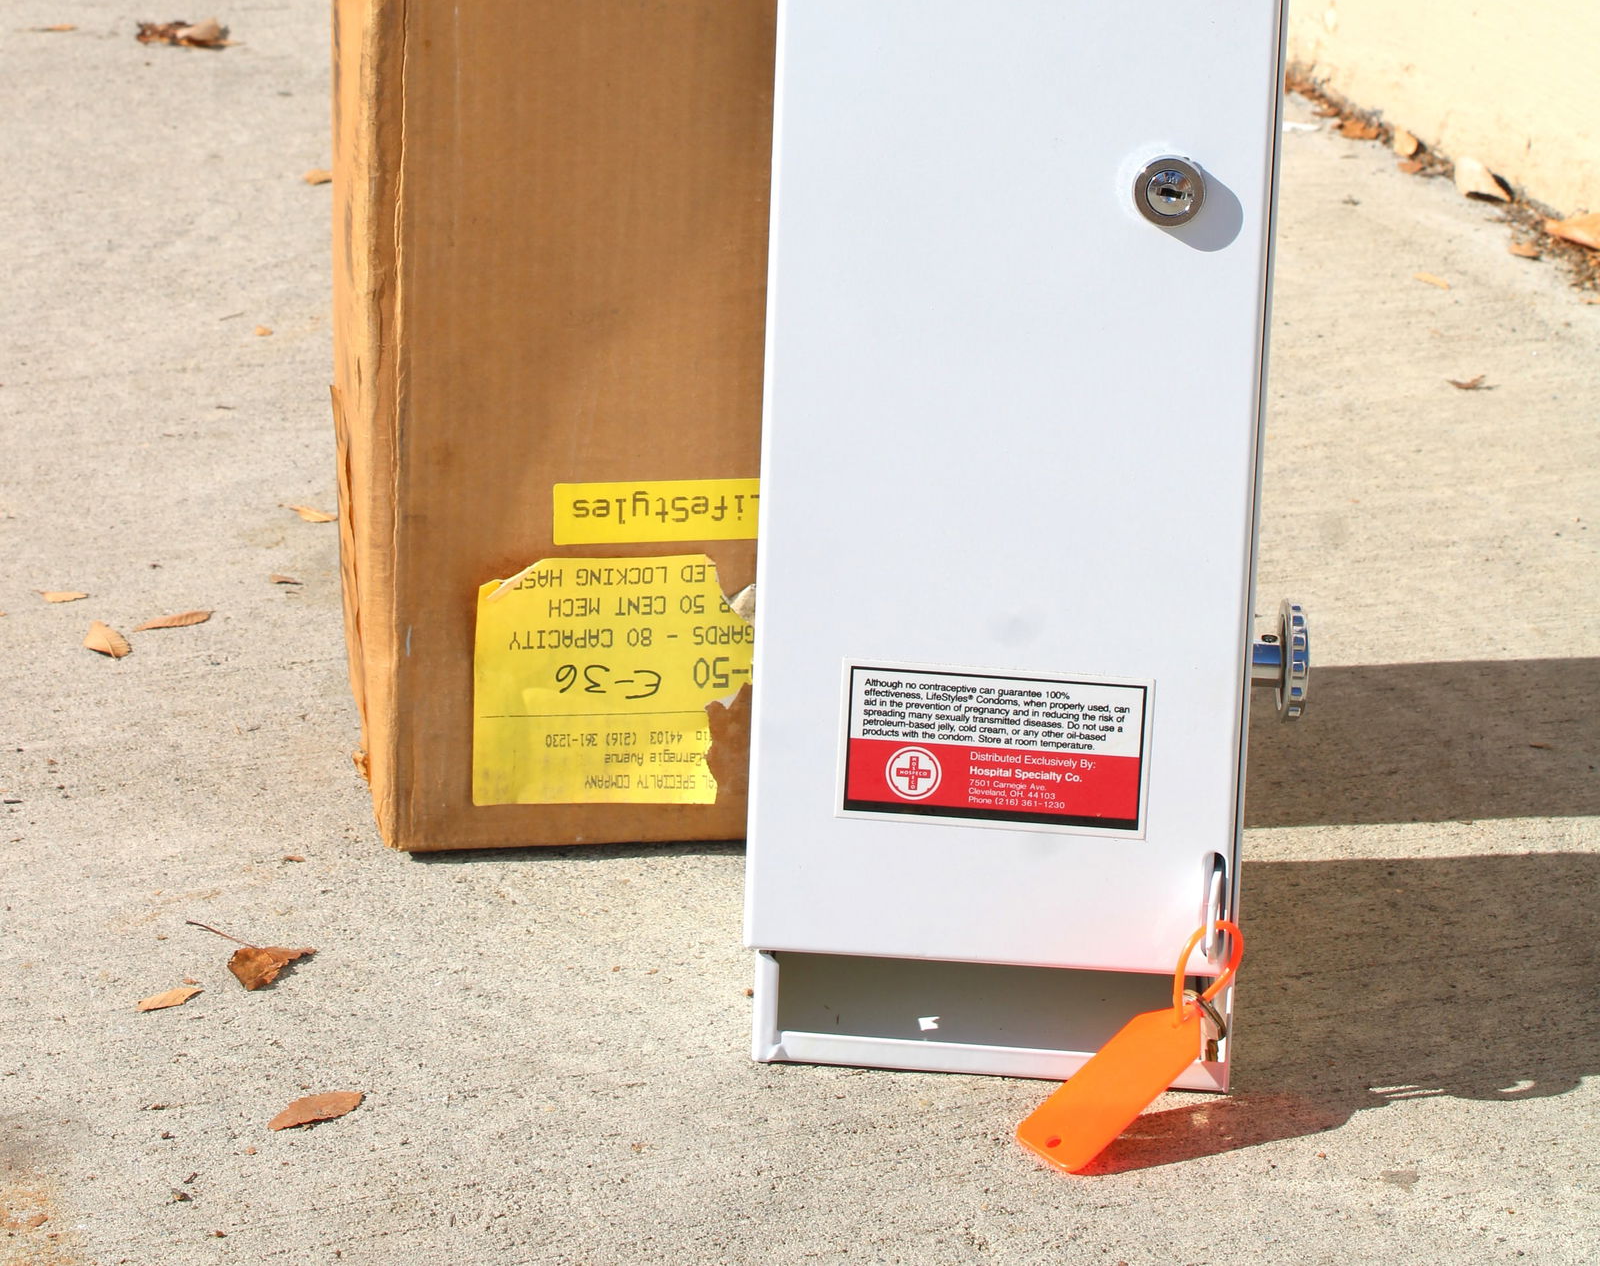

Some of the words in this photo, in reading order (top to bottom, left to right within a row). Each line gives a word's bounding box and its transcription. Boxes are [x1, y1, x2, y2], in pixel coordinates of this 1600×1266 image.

[573, 490, 761, 524] ifeStyles
[576, 566, 668, 586] LOCKING
[548, 598, 601, 618] MECH
[615, 596, 666, 617] CENT
[680, 595, 705, 614] 50
[509, 629, 614, 651] CAPACITY
[626, 628, 653, 647] 80
[865, 678, 902, 690] Although
[919, 681, 976, 695] contraceptive
[998, 686, 1041, 699] guarantee
[1046, 690, 1069, 699] 100%
[864, 687, 922, 700] effectiveness,
[976, 695, 1019, 706] Condoms,
[1023, 698, 1046, 707] when
[1049, 700, 1084, 712] properly
[1087, 702, 1110, 712] used,
[864, 697, 876, 706] aid
[879, 698, 886, 706] in
[889, 699, 902, 707] the
[905, 700, 950, 713] prevention
[953, 703, 961, 711] of
[964, 706, 1009, 717] pregnancy
[1012, 707, 1028, 716] and
[1032, 708, 1038, 716] in
[1042, 709, 1079, 721] reducing
[1082, 711, 1095, 720] the
[1098, 712, 1112, 721] risk
[1116, 714, 1124, 722] of
[864, 707, 905, 720] spreading
[908, 712, 932, 721] many
[935, 711, 969, 724] sexually
[972, 714, 1020, 725] transmitted
[1023, 717, 1064, 728] diseases.
[1067, 720, 1079, 729] Do
[1082, 721, 1095, 730] not
[863, 716, 934, 731] petroleum-based
[938, 721, 954, 733] jelly,
[958, 723, 976, 732] cold
[979, 726, 1007, 735] cream,
[1023, 729, 1038, 738] any
[1041, 728, 1063, 737] other
[1066, 730, 1105, 740] oil-based
[545, 732, 598, 747] 361-1230
[606, 732, 637, 747] (216)
[649, 731, 683, 745] 44103
[862, 726, 898, 738] products
[902, 729, 918, 737] with
[922, 730, 934, 739] the
[938, 731, 974, 741] condom.
[978, 734, 1000, 743] Store
[1004, 735, 1011, 744] at
[1040, 738, 1094, 751] temperature.
[604, 753, 645, 766] Avenue
[970, 751, 1021, 764] Distributed
[1024, 755, 1077, 769] Exclusively
[1080, 758, 1095, 770] By:
[584, 775, 630, 789] COMPANY
[636, 774, 696, 789] SPECIALTY
[970, 766, 1011, 779] Hospital
[1014, 768, 1062, 782] Specialty
[1065, 772, 1081, 782] Co.
[968, 787, 1008, 797] Cleveland,
[1028, 790, 1055, 799] 44103
[970, 778, 989, 786] 7501
[993, 780, 1026, 791] Carnegie
[968, 795, 991, 803] Phone
[995, 797, 1017, 805] (216)
[1021, 799, 1064, 808] 361-1230
